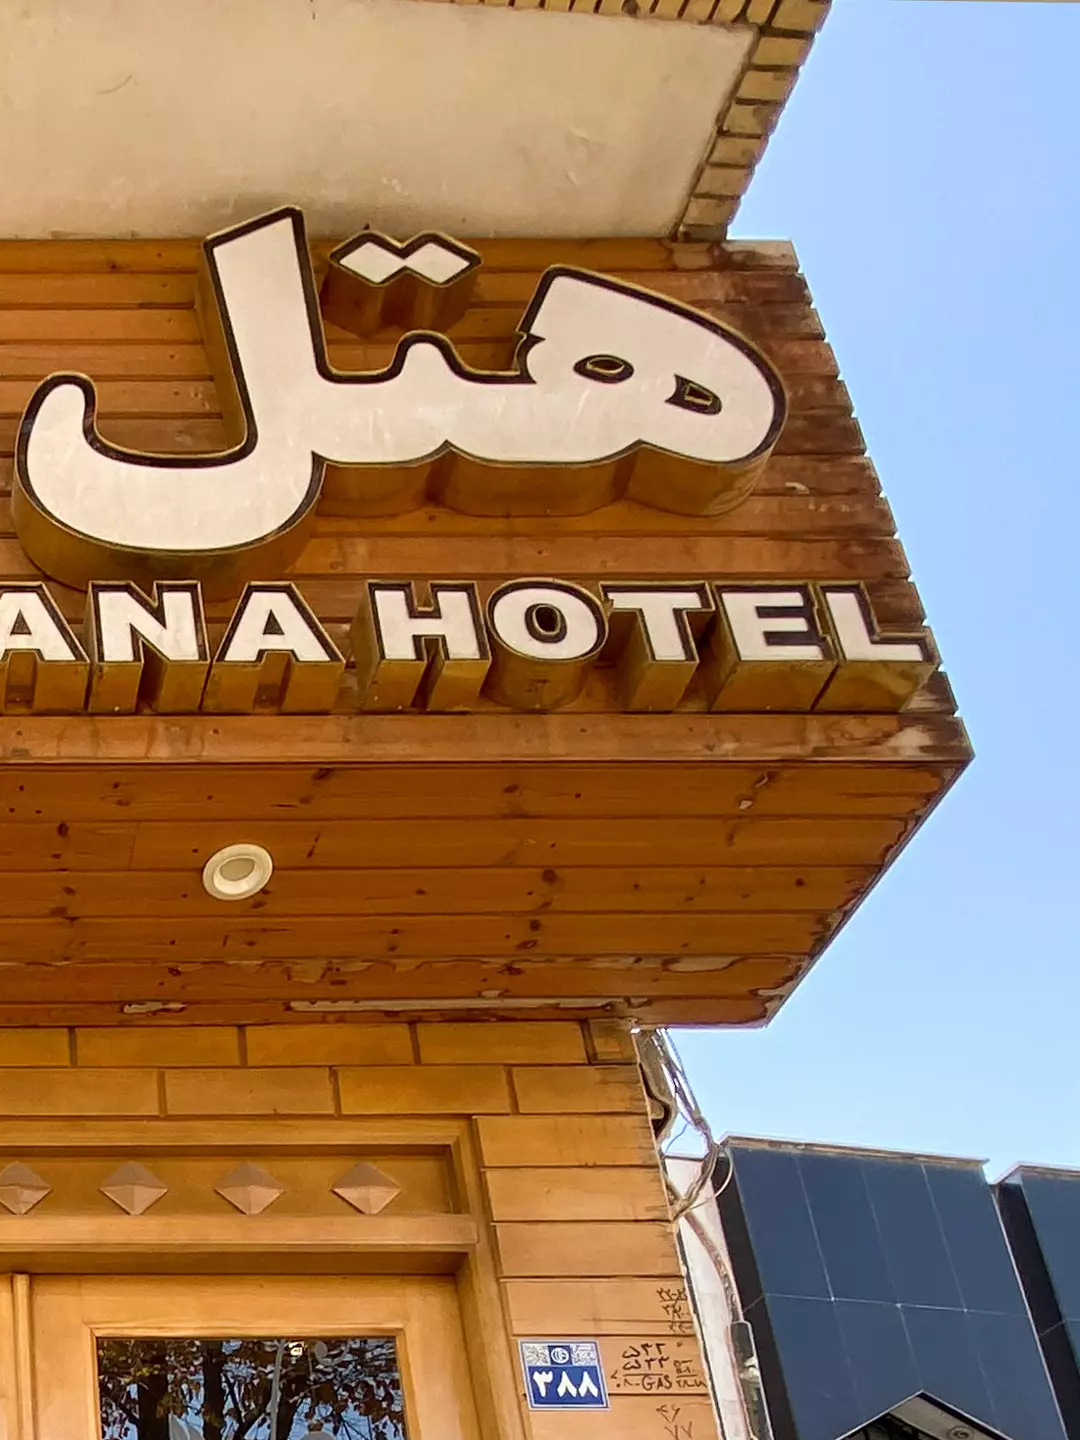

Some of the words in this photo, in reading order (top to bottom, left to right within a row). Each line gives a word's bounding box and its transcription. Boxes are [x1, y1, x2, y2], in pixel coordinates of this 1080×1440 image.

[17, 205, 790, 556] هتل
[368, 578, 934, 664] HOTEL
[532, 1370, 599, 1398] ۳۸۸
